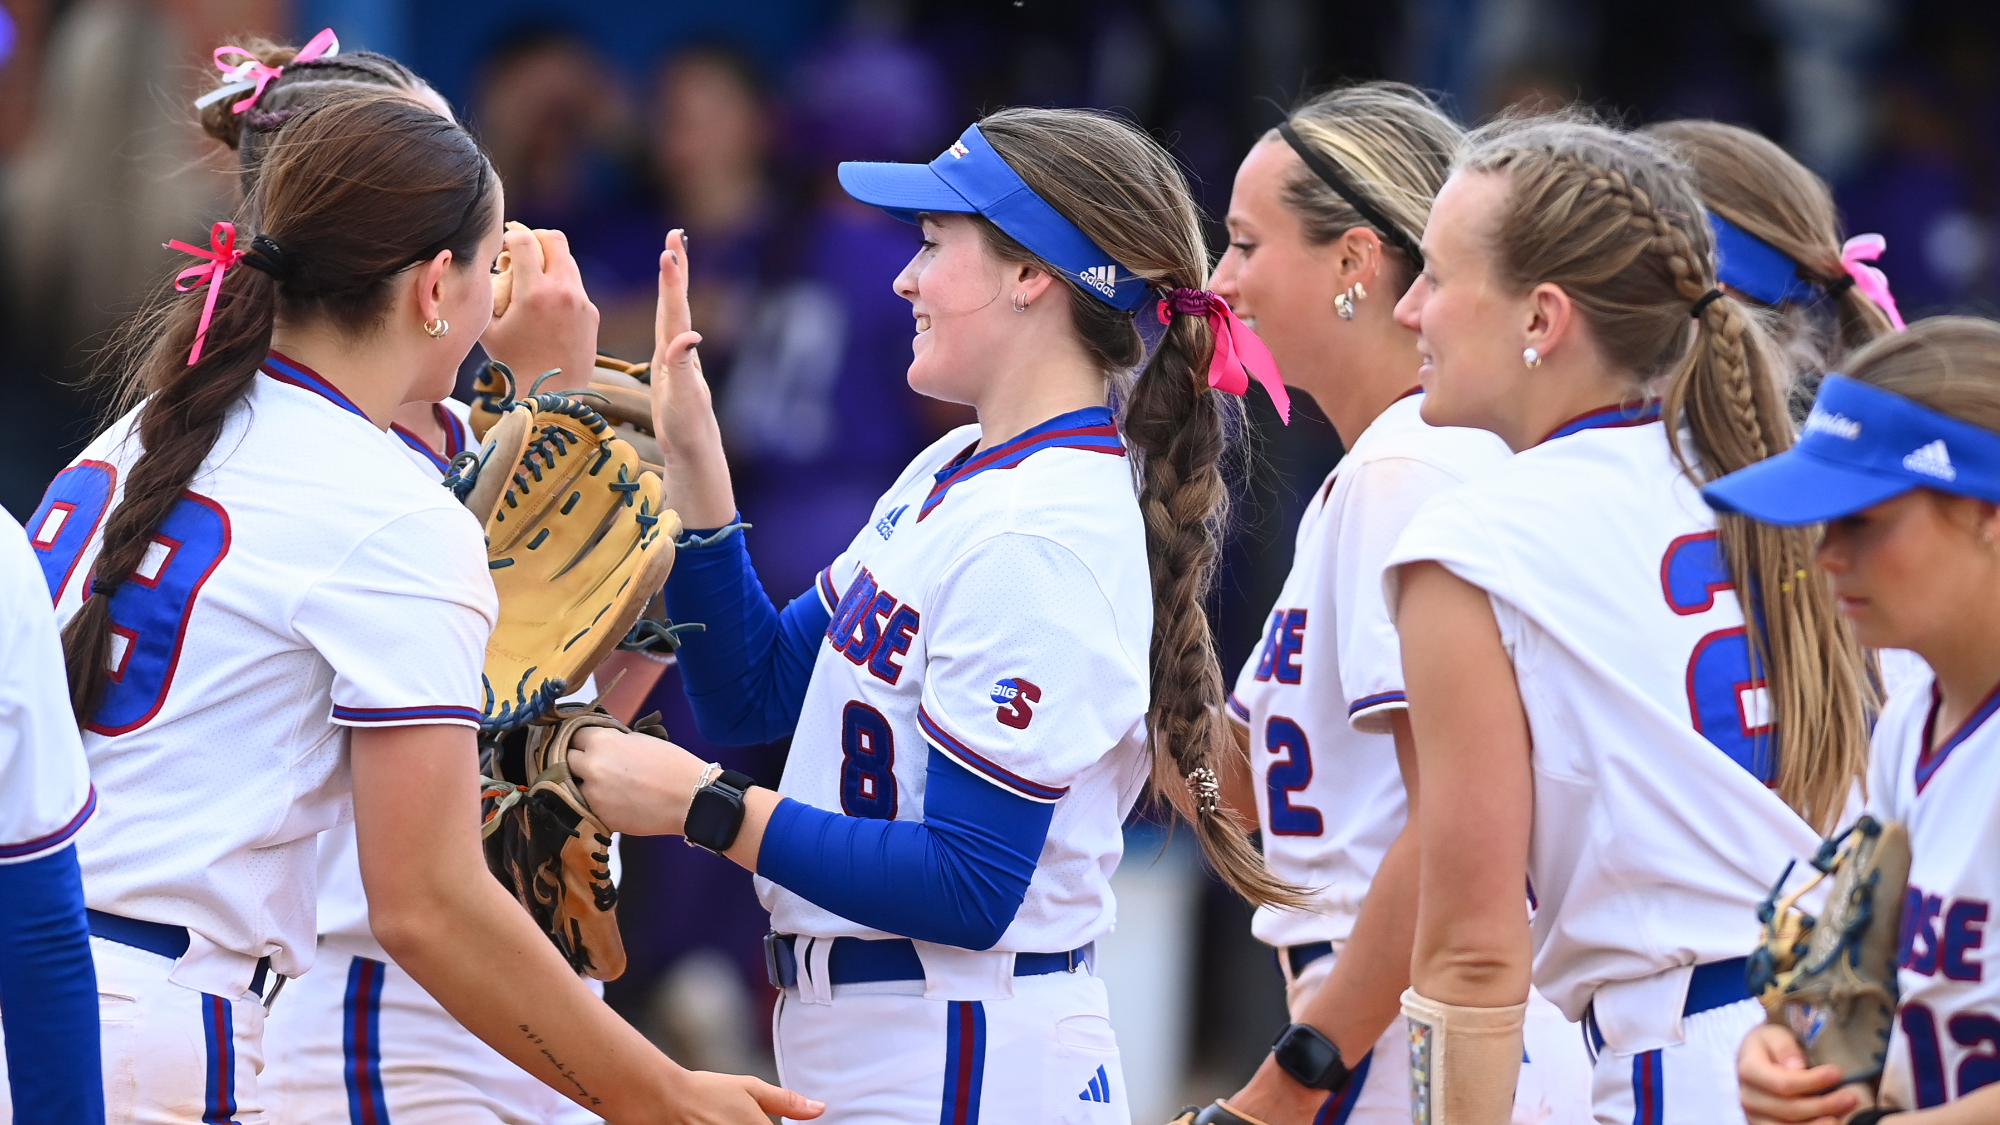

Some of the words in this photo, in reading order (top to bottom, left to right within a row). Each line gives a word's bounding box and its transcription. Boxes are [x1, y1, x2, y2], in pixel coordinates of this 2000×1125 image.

[1080, 271, 1116, 298] adidas
[991, 685, 1018, 700] BIG
[996, 678, 1042, 730] S
[840, 699, 898, 821] 8
[1265, 715, 1324, 837] 2
[1901, 1001, 2000, 1110] 12
